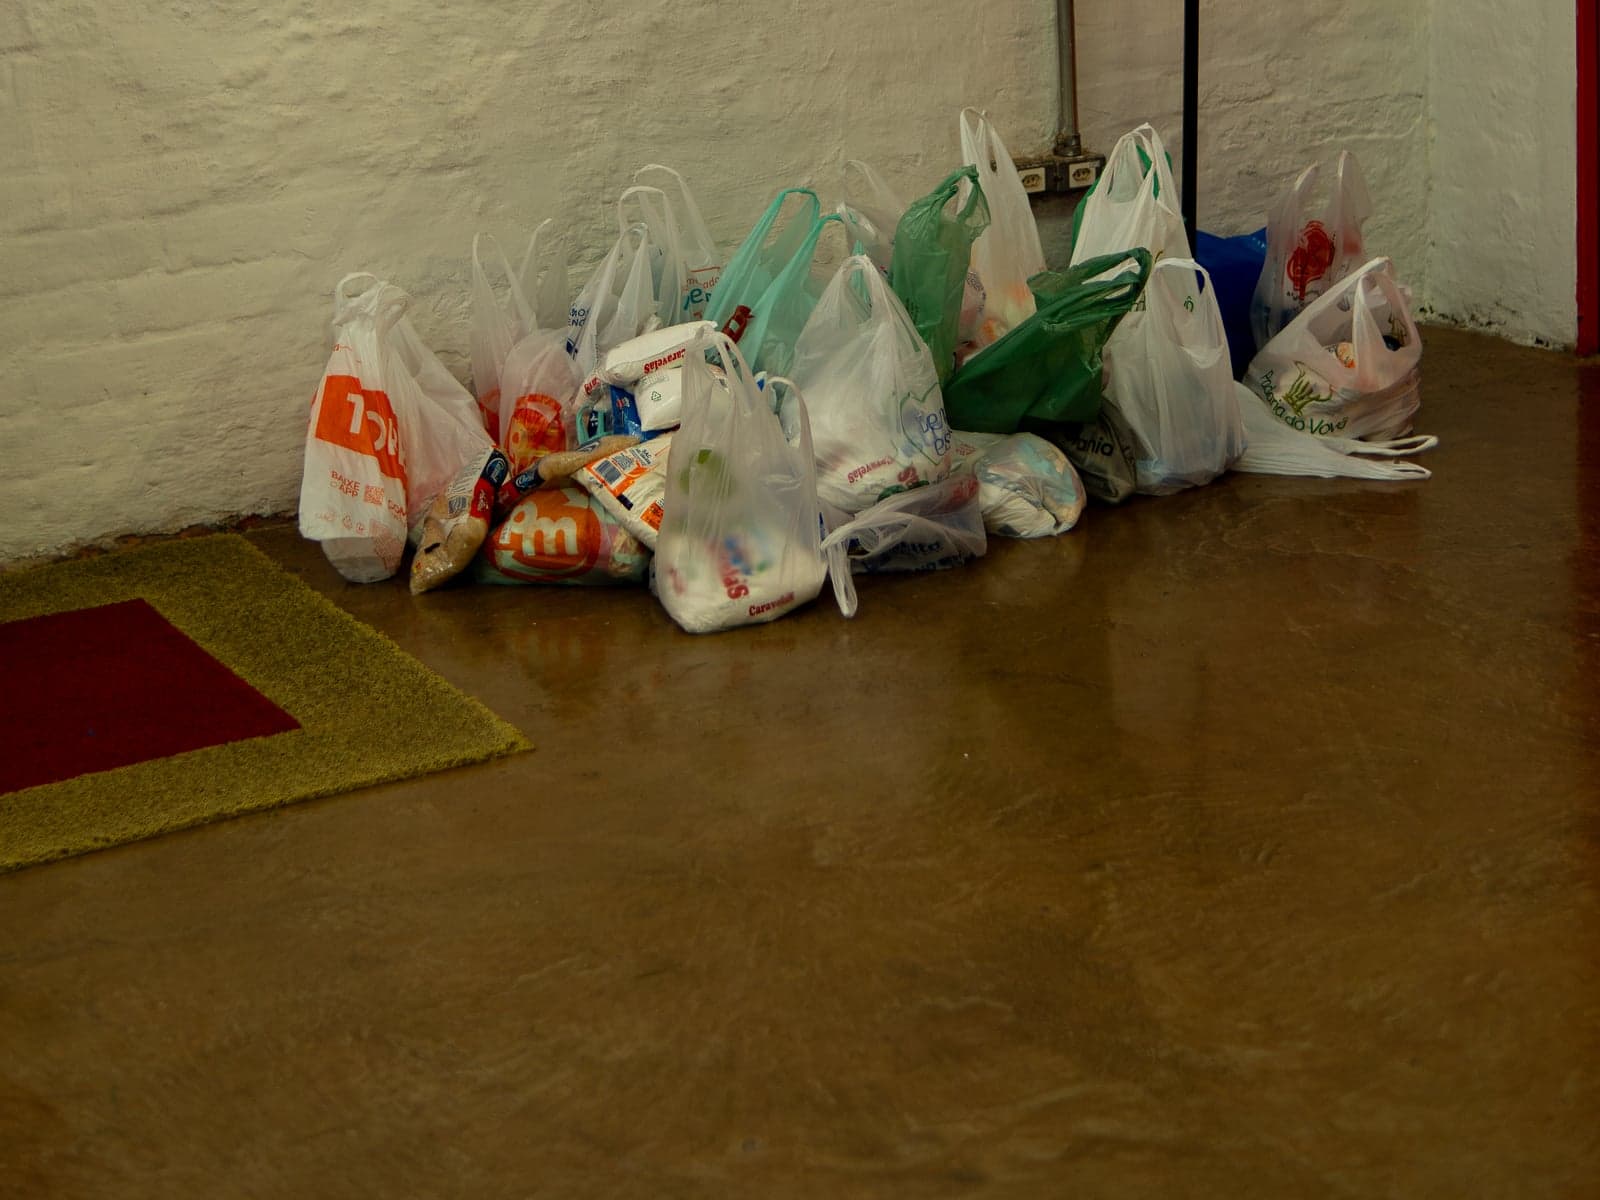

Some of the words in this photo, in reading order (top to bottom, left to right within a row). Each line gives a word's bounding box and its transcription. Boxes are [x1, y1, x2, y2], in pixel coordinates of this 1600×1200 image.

[1285, 416, 1305, 431] do
[331, 470, 361, 492] BAIXE
[339, 484, 359, 497] APP
